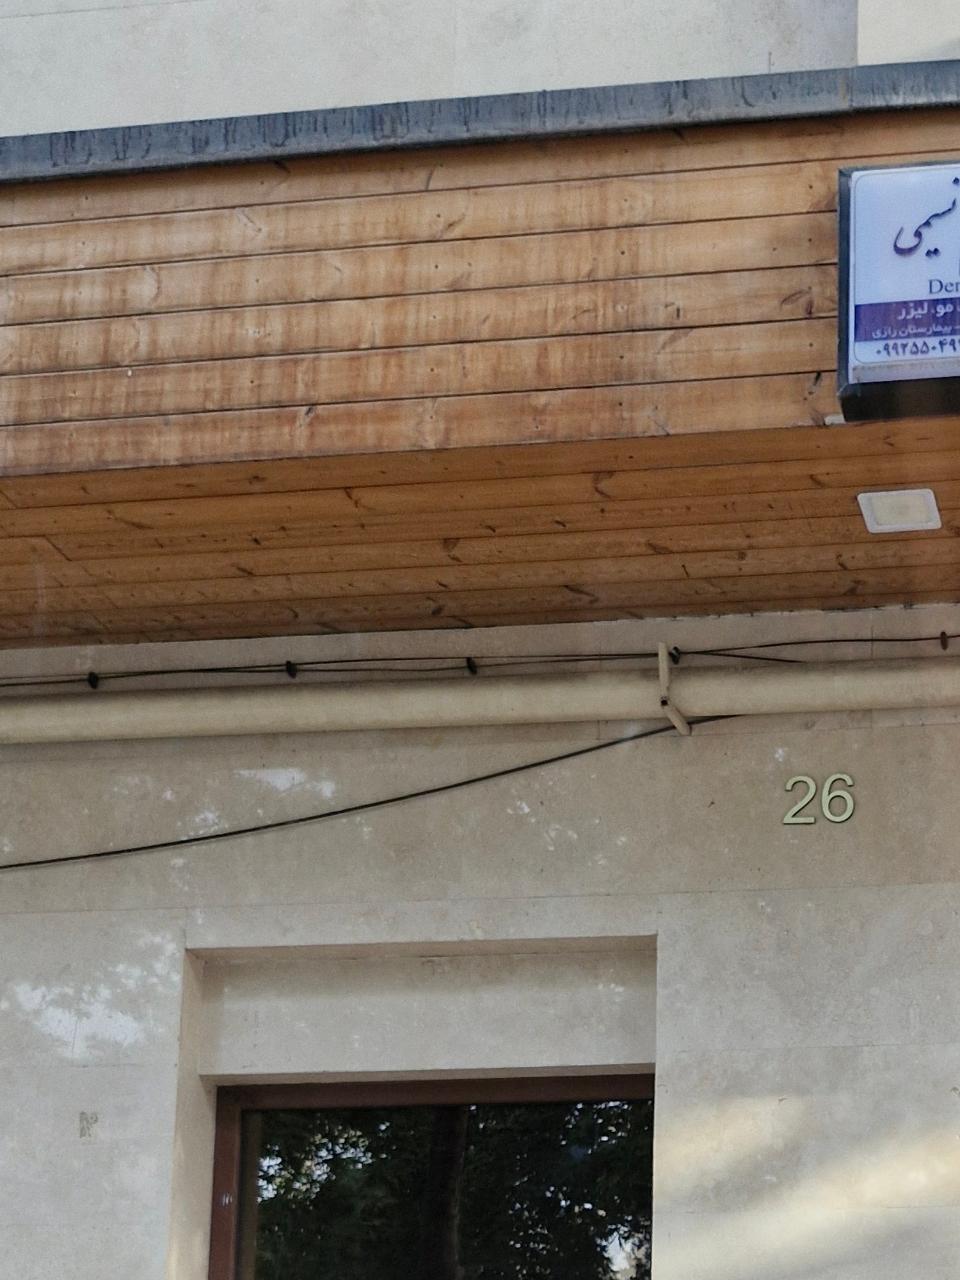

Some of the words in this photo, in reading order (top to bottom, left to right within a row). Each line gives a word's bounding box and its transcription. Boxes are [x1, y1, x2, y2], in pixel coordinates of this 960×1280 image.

[893, 176, 960, 257] نسیمی
[897, 301, 929, 320] لیزر
[872, 325, 897, 340] رازی
[898, 322, 953, 337] بیمارستان
[783, 773, 855, 825] 26
